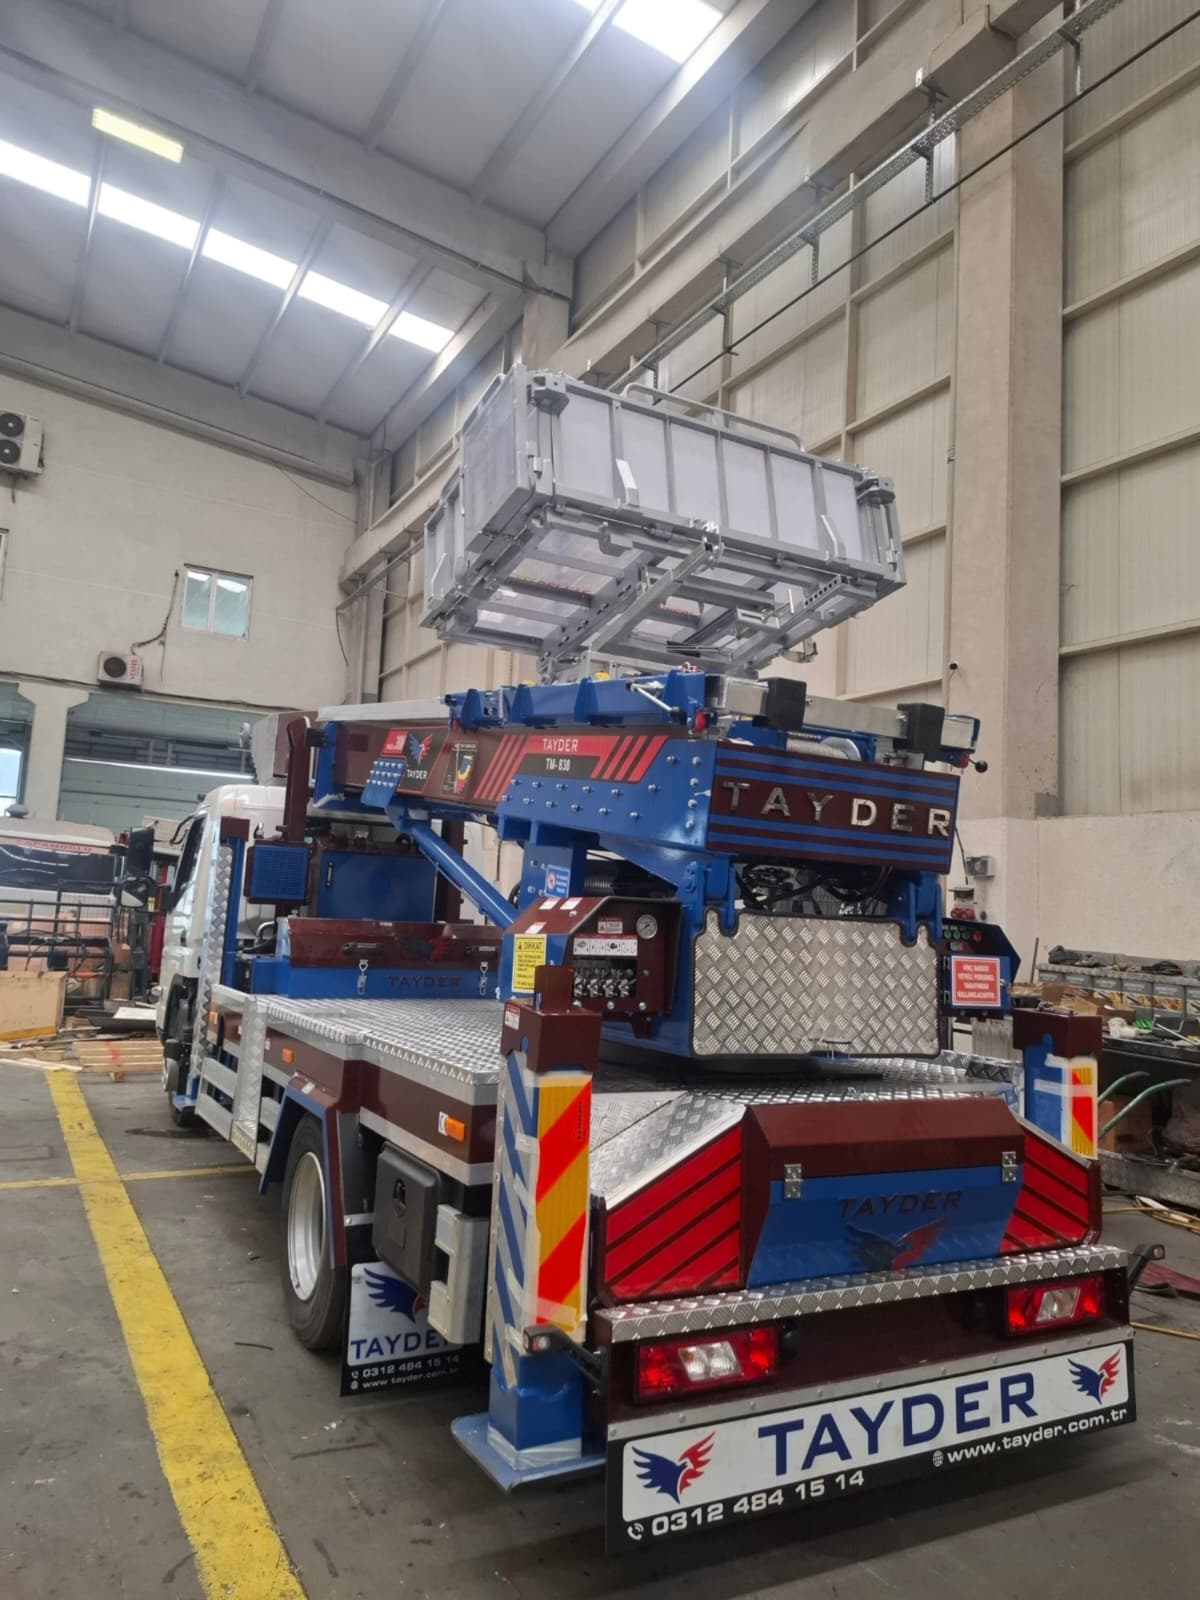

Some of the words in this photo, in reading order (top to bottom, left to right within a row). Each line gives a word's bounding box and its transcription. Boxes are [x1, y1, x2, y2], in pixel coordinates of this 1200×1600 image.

[543, 738, 579, 753] TAYDER
[407, 769, 428, 780] TAYDER
[722, 781, 951, 837] TAYDER
[388, 976, 461, 988] TAYDER
[839, 1190, 963, 1218] TAYDER
[350, 1330, 448, 1360] TAYDE
[362, 1365, 395, 1379] 0312
[398, 1360, 422, 1373] 484
[757, 1371, 1038, 1477] TAYDER
[947, 1408, 1127, 1464] www.tayder.com.tr
[651, 1502, 724, 1536] 0312
[733, 1489, 785, 1515] 484
[795, 1478, 825, 1501] 15
[835, 1469, 865, 1491] 14
